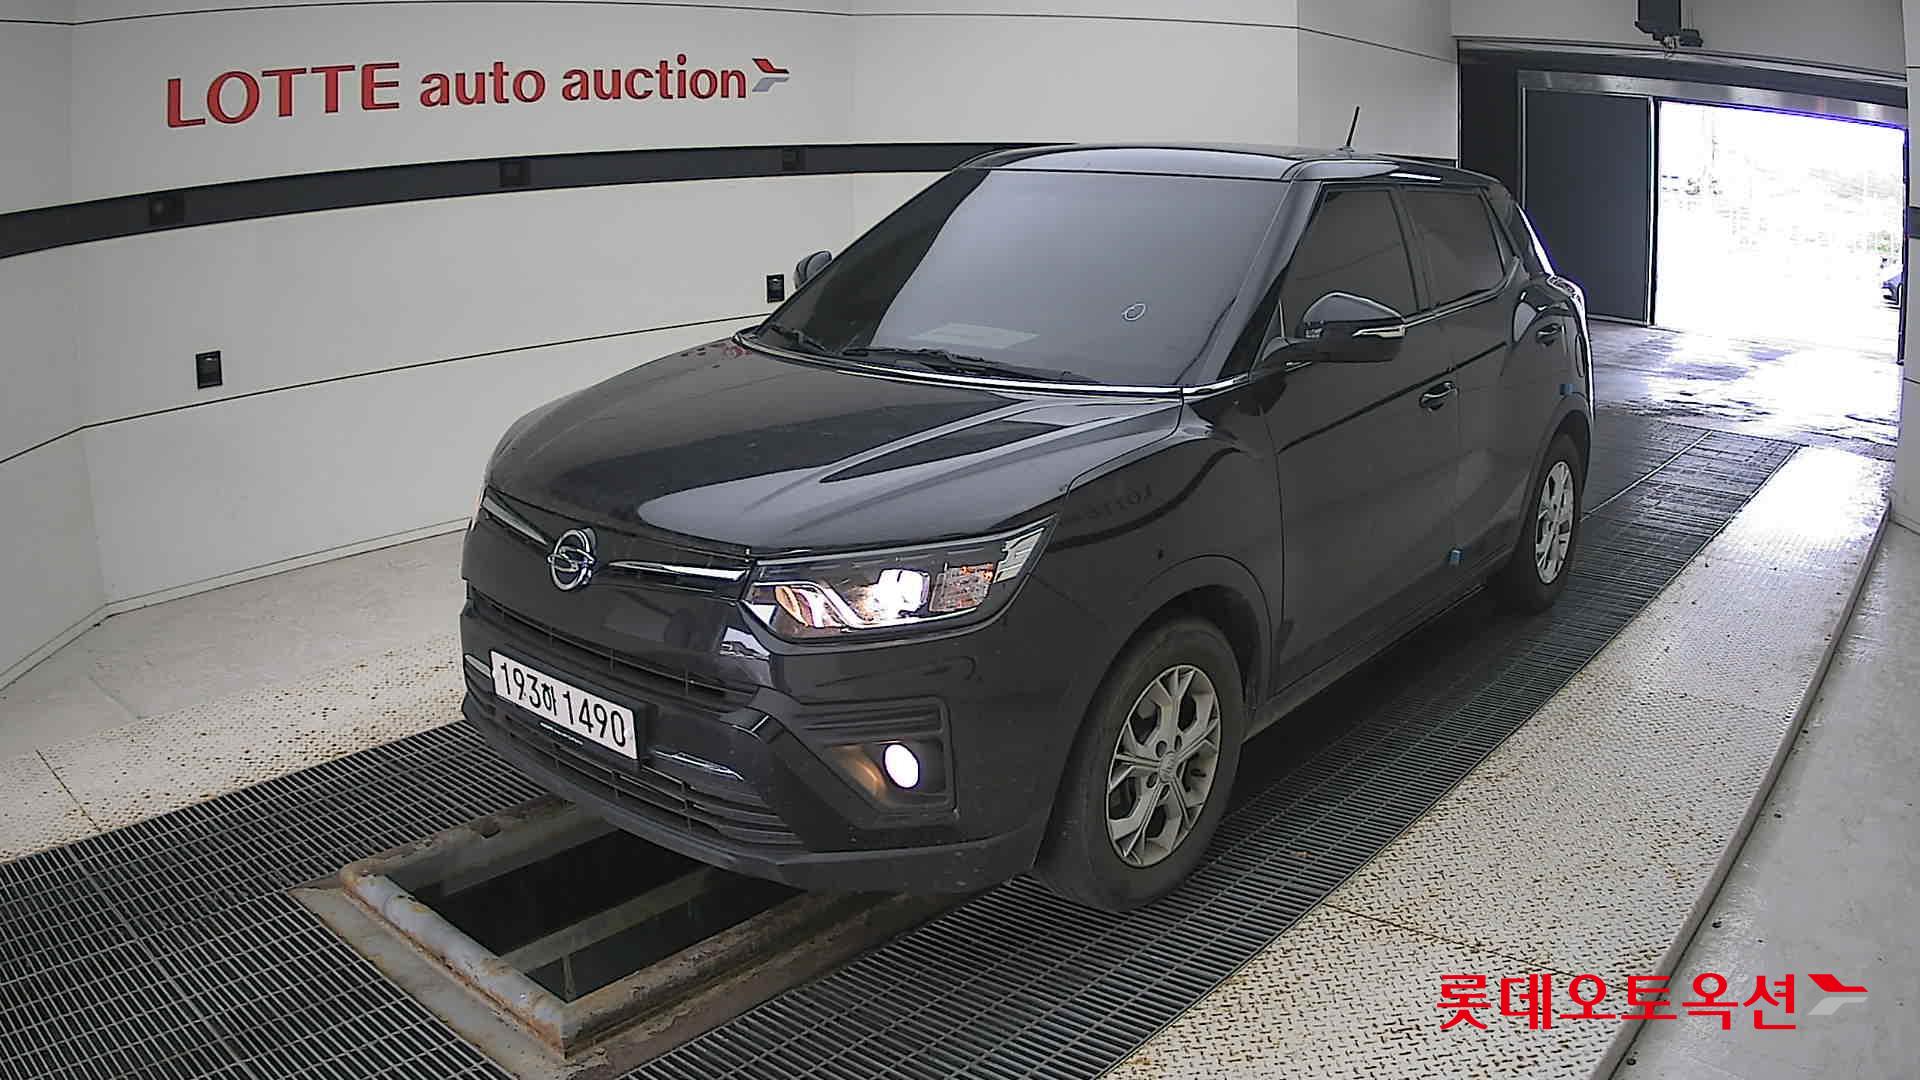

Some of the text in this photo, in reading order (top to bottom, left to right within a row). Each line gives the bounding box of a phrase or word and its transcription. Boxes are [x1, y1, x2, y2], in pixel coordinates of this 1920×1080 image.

[166, 53, 747, 128] LOTTE auto auction
